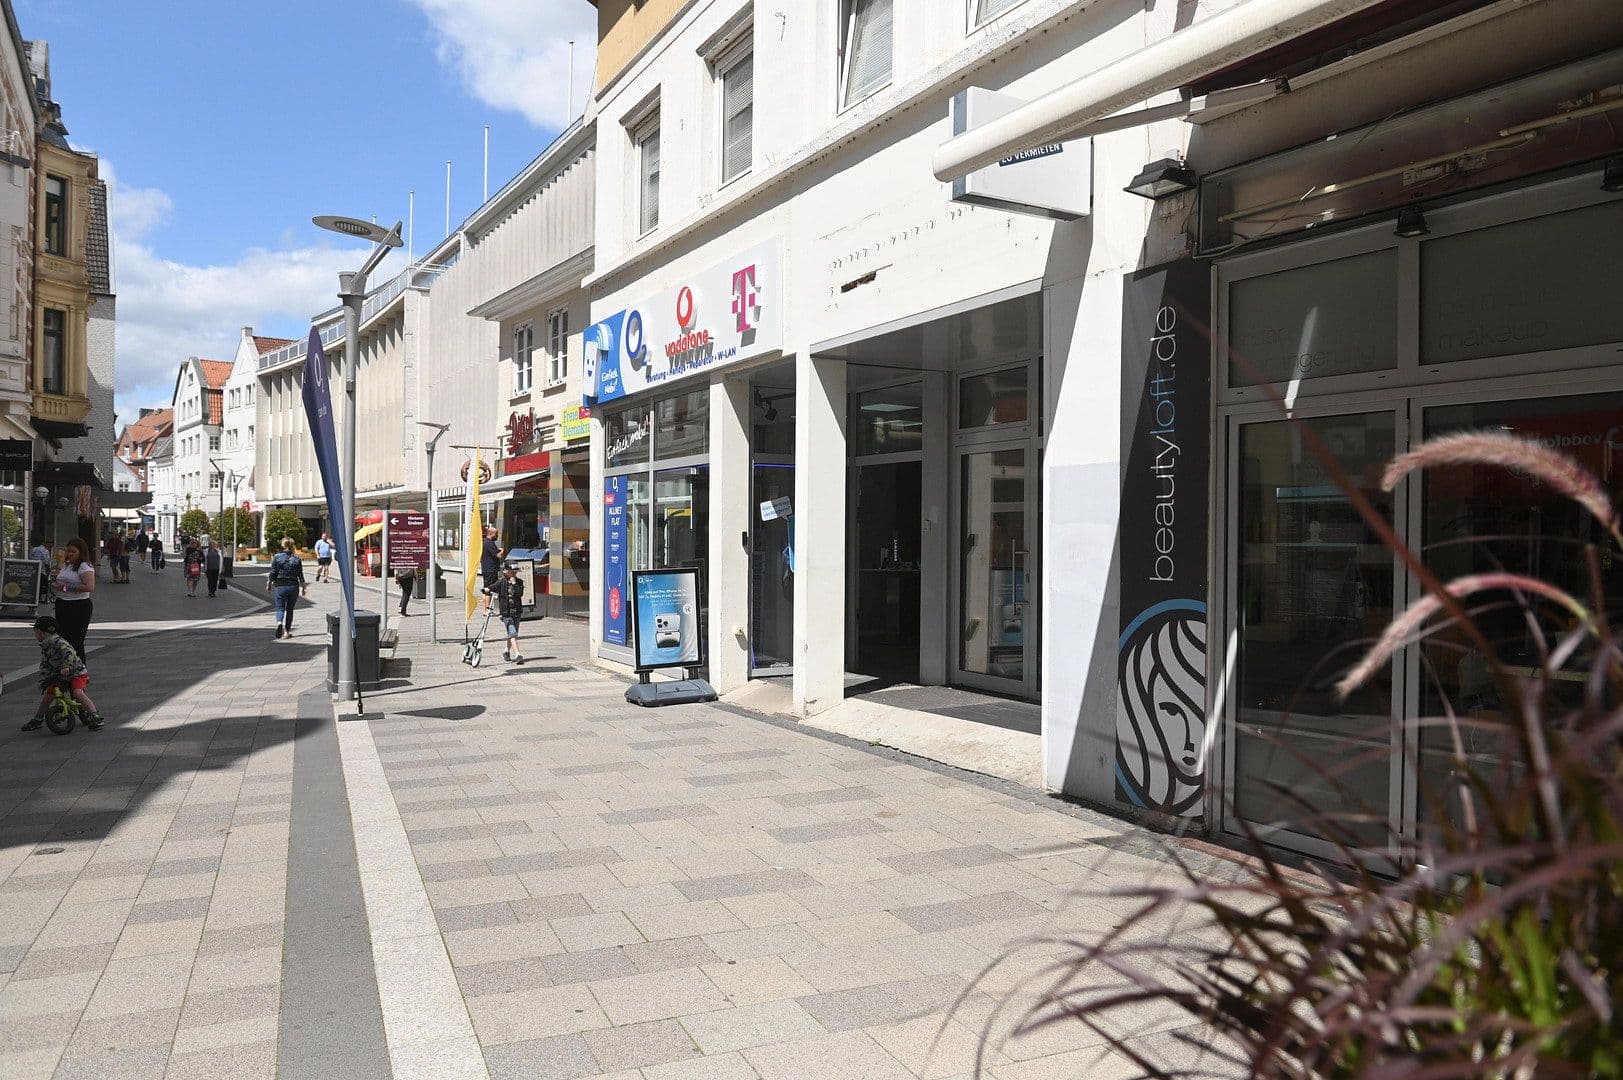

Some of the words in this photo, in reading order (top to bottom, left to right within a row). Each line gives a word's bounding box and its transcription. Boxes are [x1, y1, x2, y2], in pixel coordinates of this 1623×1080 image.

[1014, 144, 1060, 160] VERMIETEN
[664, 329, 709, 357] vodafone
[563, 410, 579, 424] Freie
[1149, 305, 1181, 582] beautyloft.de
